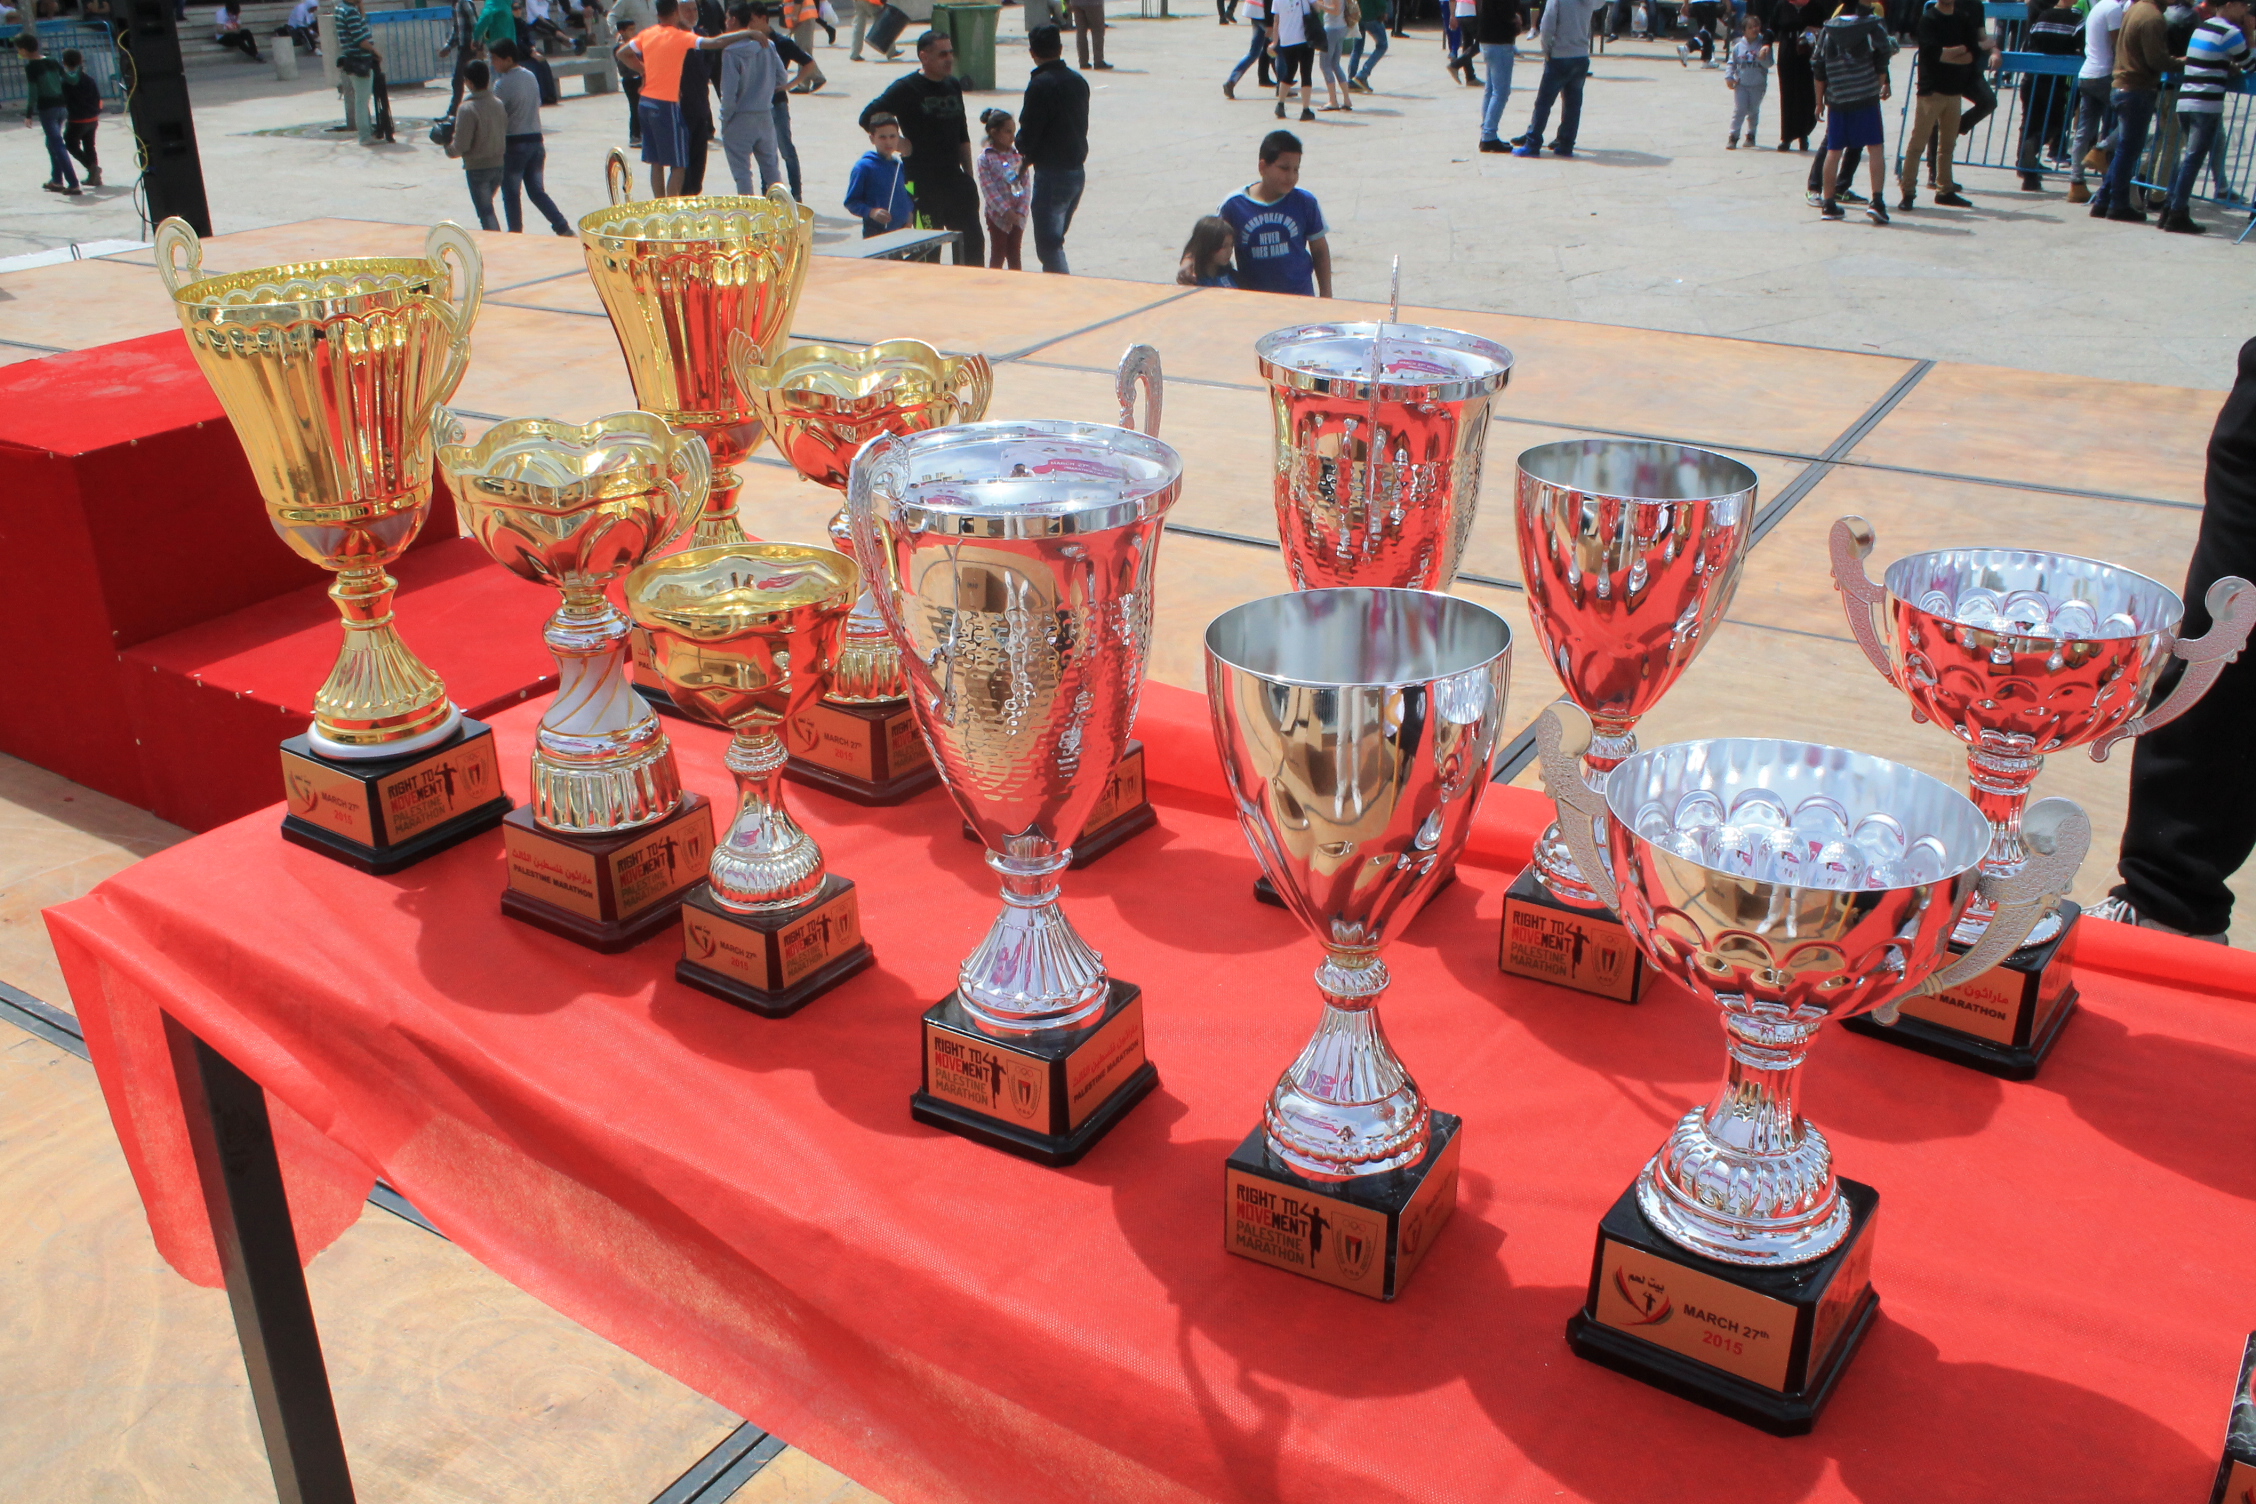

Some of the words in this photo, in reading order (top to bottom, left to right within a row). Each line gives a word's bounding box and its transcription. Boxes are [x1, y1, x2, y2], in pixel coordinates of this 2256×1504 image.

[1259, 231, 1280, 245] NEVER
[824, 732, 849, 747] MARCH
[834, 748, 854, 762] 2015
[387, 775, 417, 800] RIGHT
[420, 769, 435, 785] TO
[389, 778, 443, 814] MOVEMENT
[321, 791, 347, 809] MARCH
[392, 795, 443, 825] PALESTINE
[333, 809, 353, 825] 2015
[394, 805, 446, 834] MARATHON
[616, 849, 644, 873] RIGHT
[646, 842, 659, 858] TO
[620, 852, 666, 888] MOVEMENT
[513, 863, 551, 884] PALESTINE
[552, 878, 594, 900] MARATHON
[806, 919, 817, 933] TO
[1513, 910, 1547, 932] RIGHT
[1550, 919, 1565, 936] TO
[720, 941, 745, 957] MARCH
[1510, 941, 1567, 965] PALESTINE
[1511, 926, 1572, 954] MOVEMENT
[731, 956, 749, 971] 2015
[1510, 953, 1567, 976] MARATHON
[1939, 994, 2007, 1021] MARATHON
[1964, 984, 2009, 1004] ماراثون
[935, 1036, 965, 1059] RIGHT
[968, 1048, 982, 1065] TO
[935, 1051, 990, 1083] MOVEMENT
[1073, 1068, 1107, 1104] PALESTINE
[1106, 1038, 1139, 1074] MARATHON
[935, 1068, 987, 1095] PALESTINE
[936, 1079, 989, 1106] MARATHON
[1237, 1183, 1277, 1211] RIGHT
[1281, 1197, 1299, 1217] TO
[1236, 1200, 1309, 1238] MOVEMENT
[1236, 1220, 1304, 1252] PALESTINE
[1236, 1233, 1305, 1266] MARATHON
[1683, 1303, 1740, 1334] MARCH
[1742, 1326, 1770, 1341] 27th
[1703, 1330, 1744, 1355] 2015
